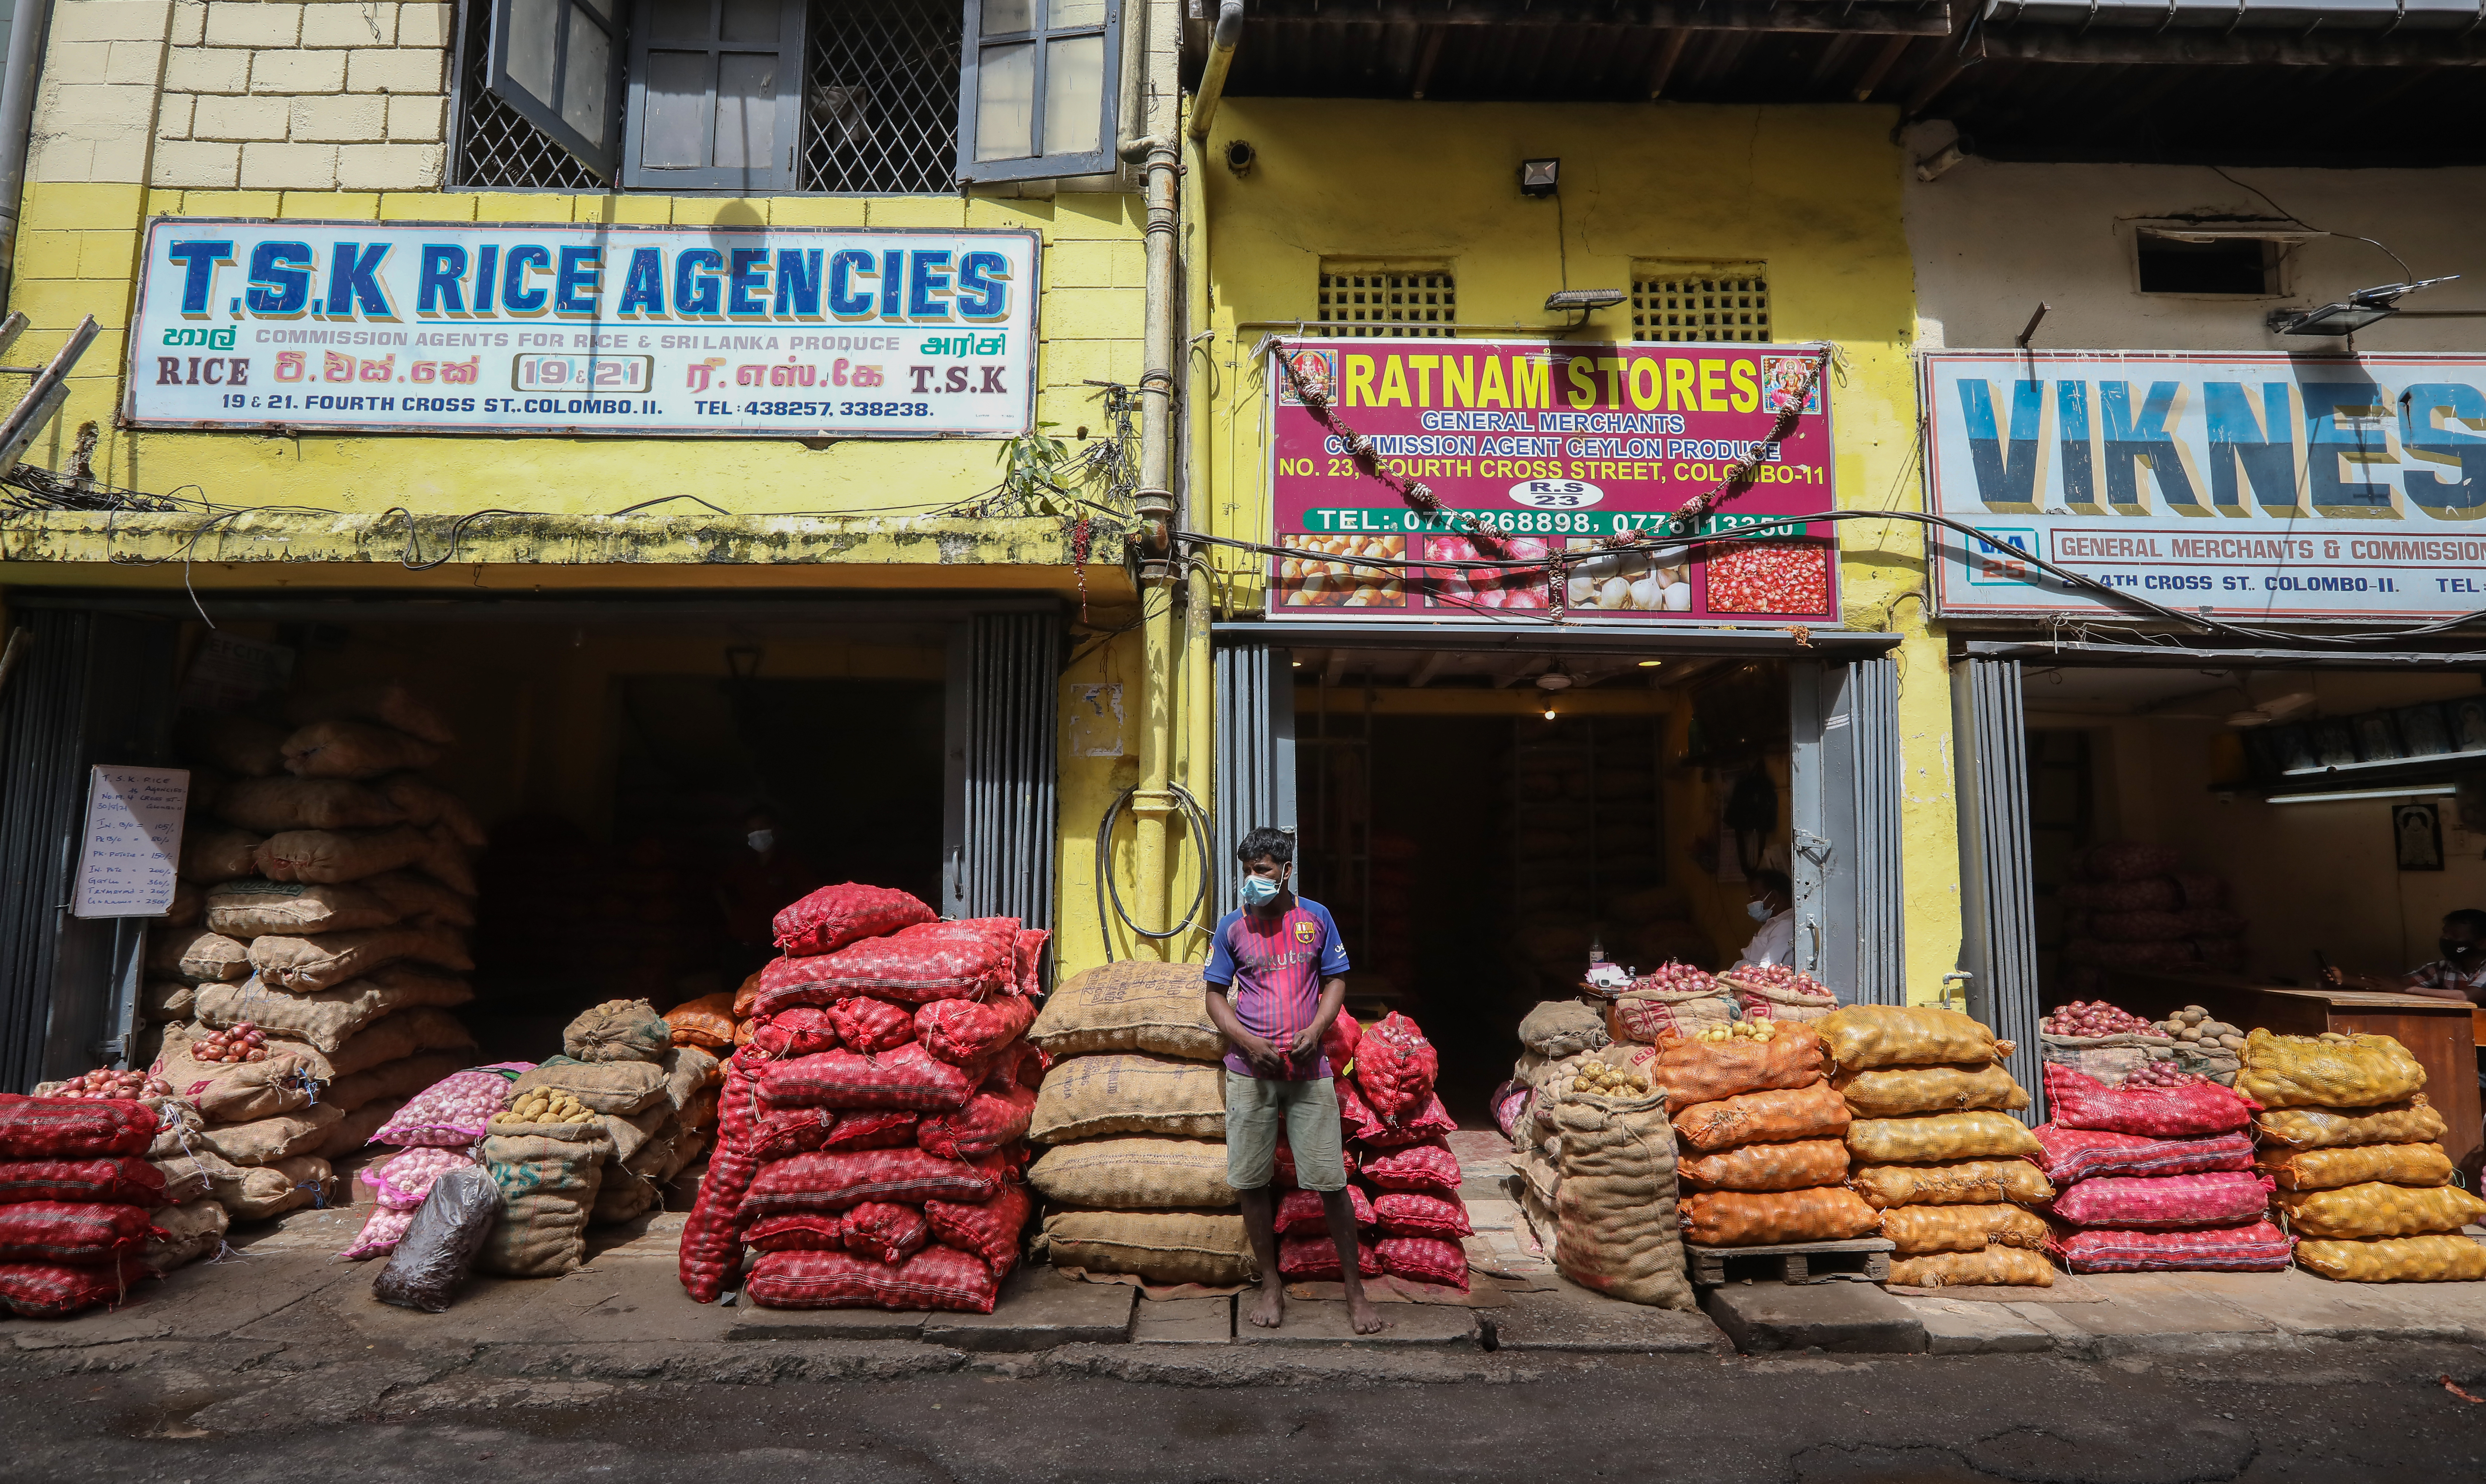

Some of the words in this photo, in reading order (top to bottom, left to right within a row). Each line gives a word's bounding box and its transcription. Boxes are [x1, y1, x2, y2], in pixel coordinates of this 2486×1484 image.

[169, 240, 402, 323] T.S.K
[417, 243, 604, 320] RICE
[617, 247, 1014, 324] AGENCIES
[162, 324, 237, 351] හාල්
[256, 329, 408, 346] COMMISSION
[415, 331, 508, 347] AGENTS
[519, 333, 564, 347] FOR
[574, 334, 627, 348] RICE
[638, 335, 651, 348] &
[790, 337, 900, 351] PRODUCE
[920, 332, 1005, 357] அரிசி
[156, 356, 250, 386] RICE
[523, 359, 570, 385] 19
[576, 371, 586, 383] &
[595, 362, 640, 386] 21
[909, 364, 1008, 394] T.S.K
[1345, 354, 1551, 409] RATNAM
[1567, 356, 1760, 413] STORES
[222, 394, 245, 408] 19
[252, 396, 261, 408] &
[306, 396, 395, 411] FOURTH
[402, 398, 475, 411] CROSS
[840, 402, 934, 416] 338238.
[1421, 411, 1535, 432] GENERAL
[1540, 412, 1685, 434] MERCHANTS
[1479, 436, 1562, 457] AGENT
[1567, 438, 1663, 459] CEYLON
[1956, 378, 2486, 522] VIKNES
[1280, 458, 1320, 476] NO.
[1327, 459, 1360, 480] 23,
[1374, 459, 1472, 477] FOURTH
[1480, 461, 1563, 479] CROSS
[1570, 462, 1667, 484] STREET,
[1530, 482, 1584, 493] R.S
[1535, 496, 1580, 506] 23
[1317, 510, 1391, 530] TEL:
[2061, 537, 2163, 557] GENERAL
[2172, 539, 2314, 559] MERCHANTS
[2323, 540, 2341, 559] &
[1982, 560, 2026, 578] 25
[2099, 574, 2138, 589] 4TH
[2145, 576, 2213, 590] CROSS
